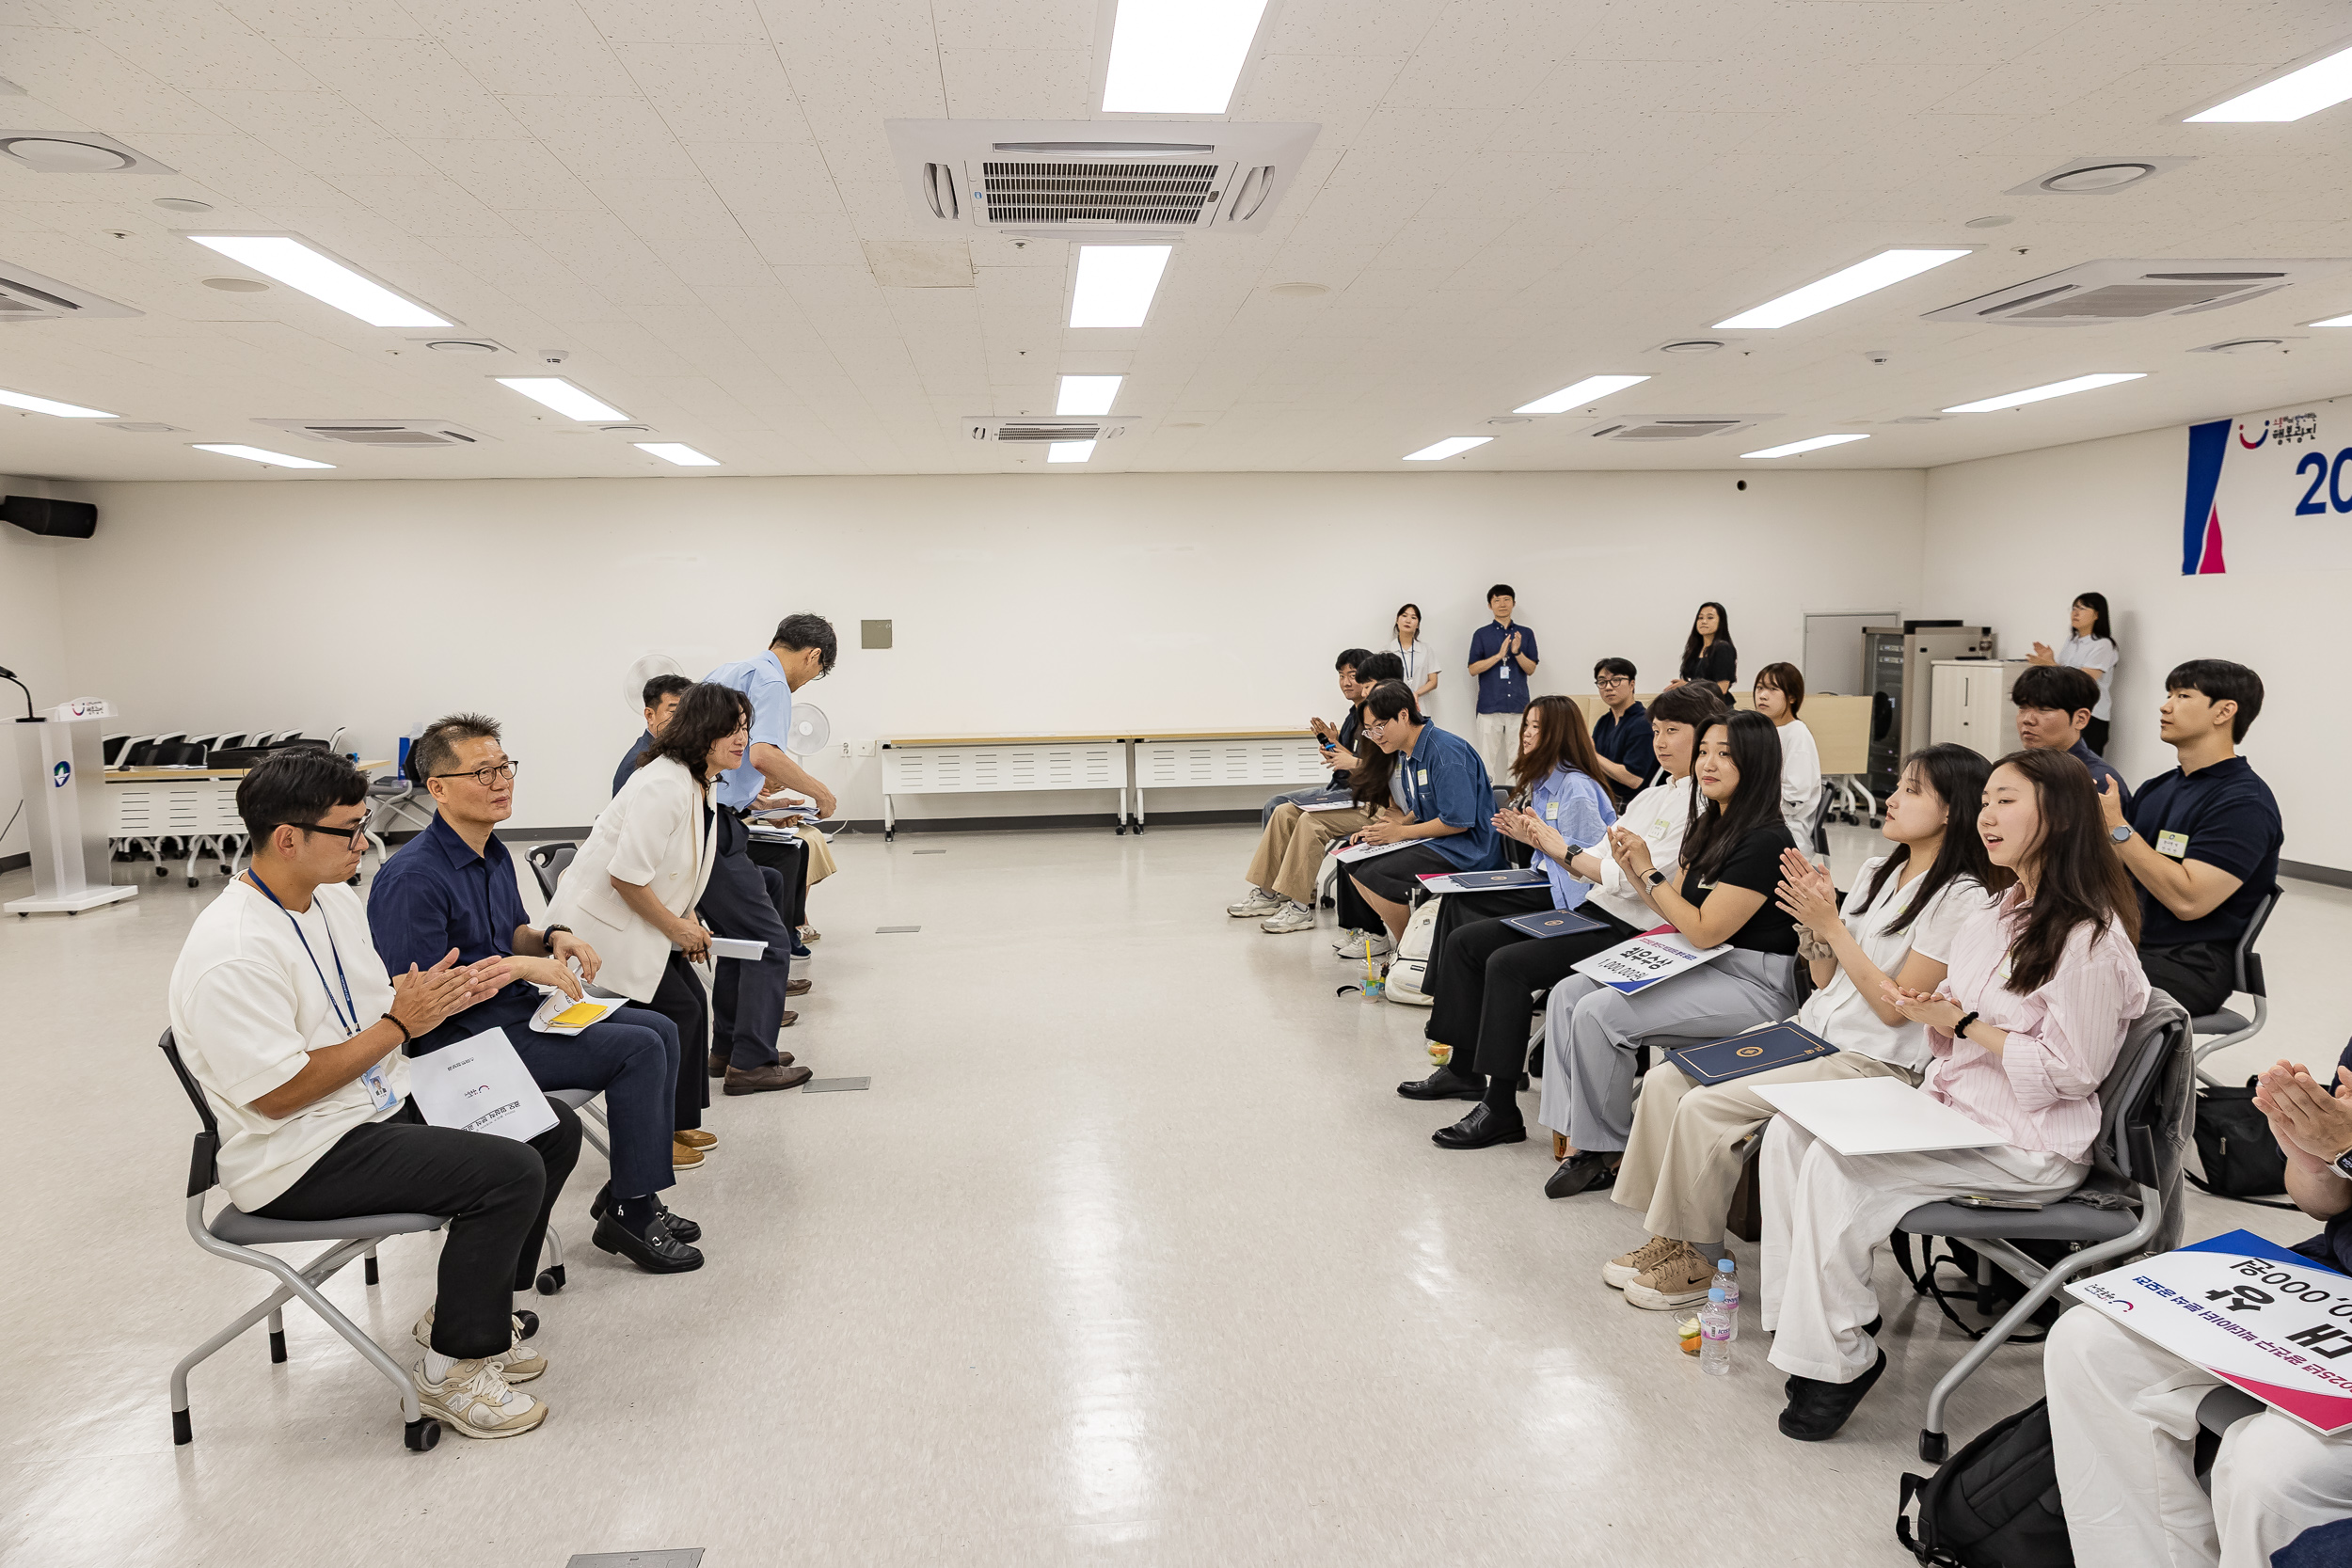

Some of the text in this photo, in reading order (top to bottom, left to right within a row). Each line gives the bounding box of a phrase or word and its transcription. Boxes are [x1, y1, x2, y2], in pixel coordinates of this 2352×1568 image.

[2272, 422, 2317, 446] 행복광진
[1598, 958, 1648, 981] 1,000,000원
[1619, 947, 1674, 970] 최우수상
[2132, 1275, 2177, 1298] 공모전
[2170, 1296, 2204, 1313] 분석
[2198, 1310, 2259, 1342] 빅데이터
[2254, 1340, 2308, 1366] 광진구
[2302, 1364, 2352, 1394] 025년
